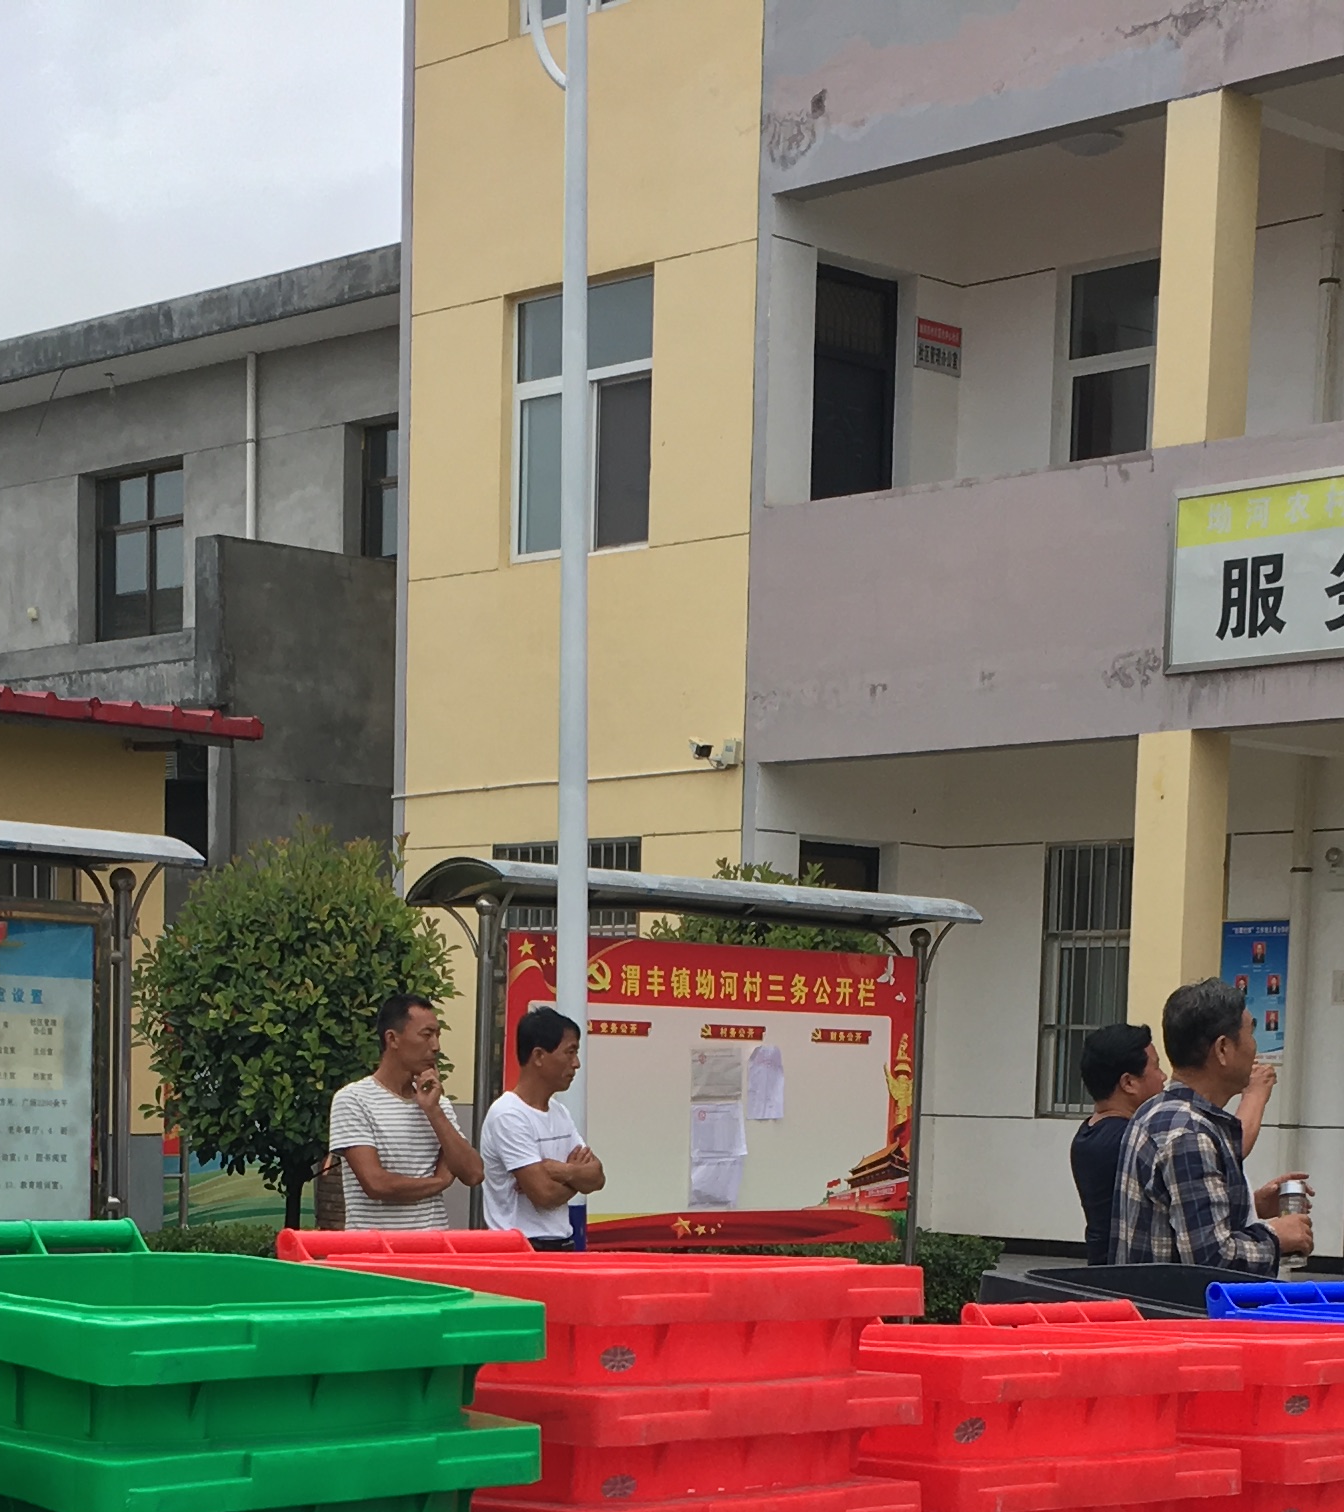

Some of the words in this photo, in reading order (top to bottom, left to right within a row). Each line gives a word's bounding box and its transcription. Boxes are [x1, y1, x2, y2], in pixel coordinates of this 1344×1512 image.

[620, 964, 875, 1007] 渭丰镇坳河村三务公开栏
[601, 1021, 637, 1035] 党务公开
[719, 1026, 755, 1039] 村务公开
[830, 1030, 863, 1042] 财务公开
